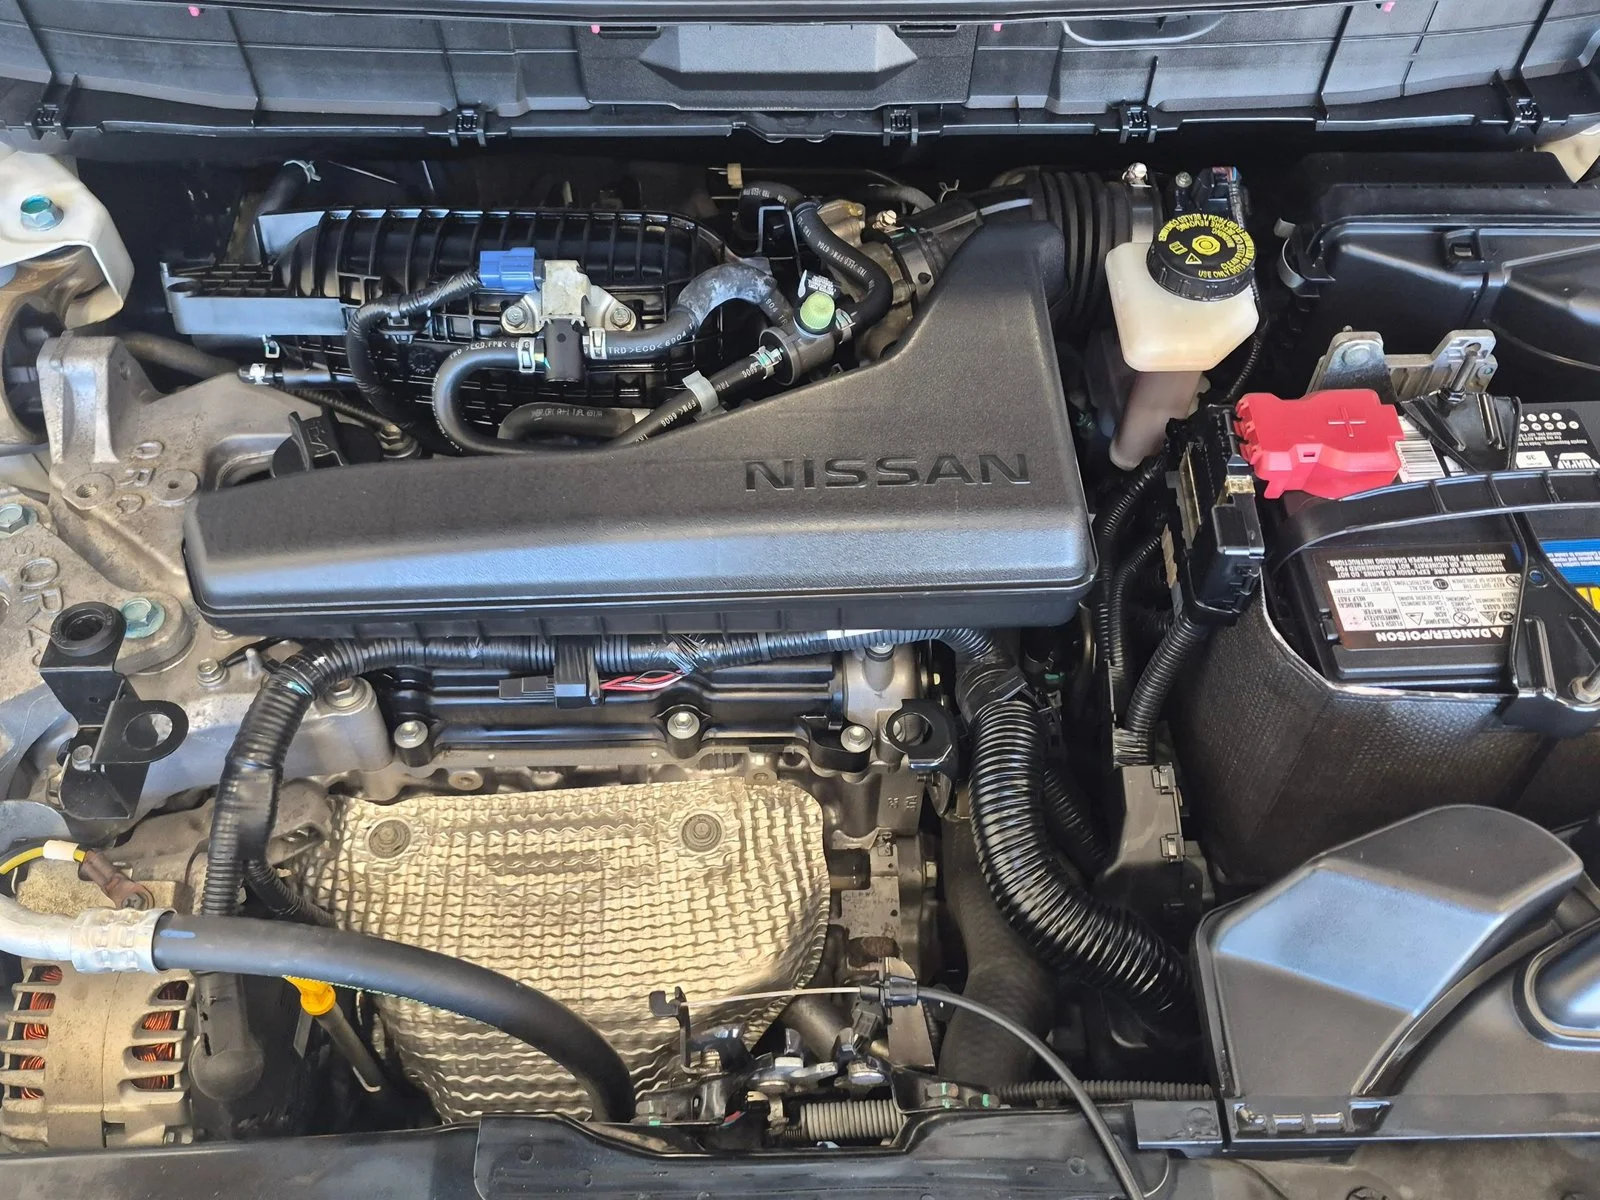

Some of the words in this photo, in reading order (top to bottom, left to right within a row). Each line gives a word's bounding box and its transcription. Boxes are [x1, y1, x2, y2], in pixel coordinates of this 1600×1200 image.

[1208, 214, 1228, 224] FROM
[1198, 270, 1212, 278] USE
[1212, 269, 1230, 278] ONLY
[608, 346, 627, 355] TRD
[745, 453, 1031, 492] NISSAN
[1375, 628, 1491, 642] DANGER/POISON
